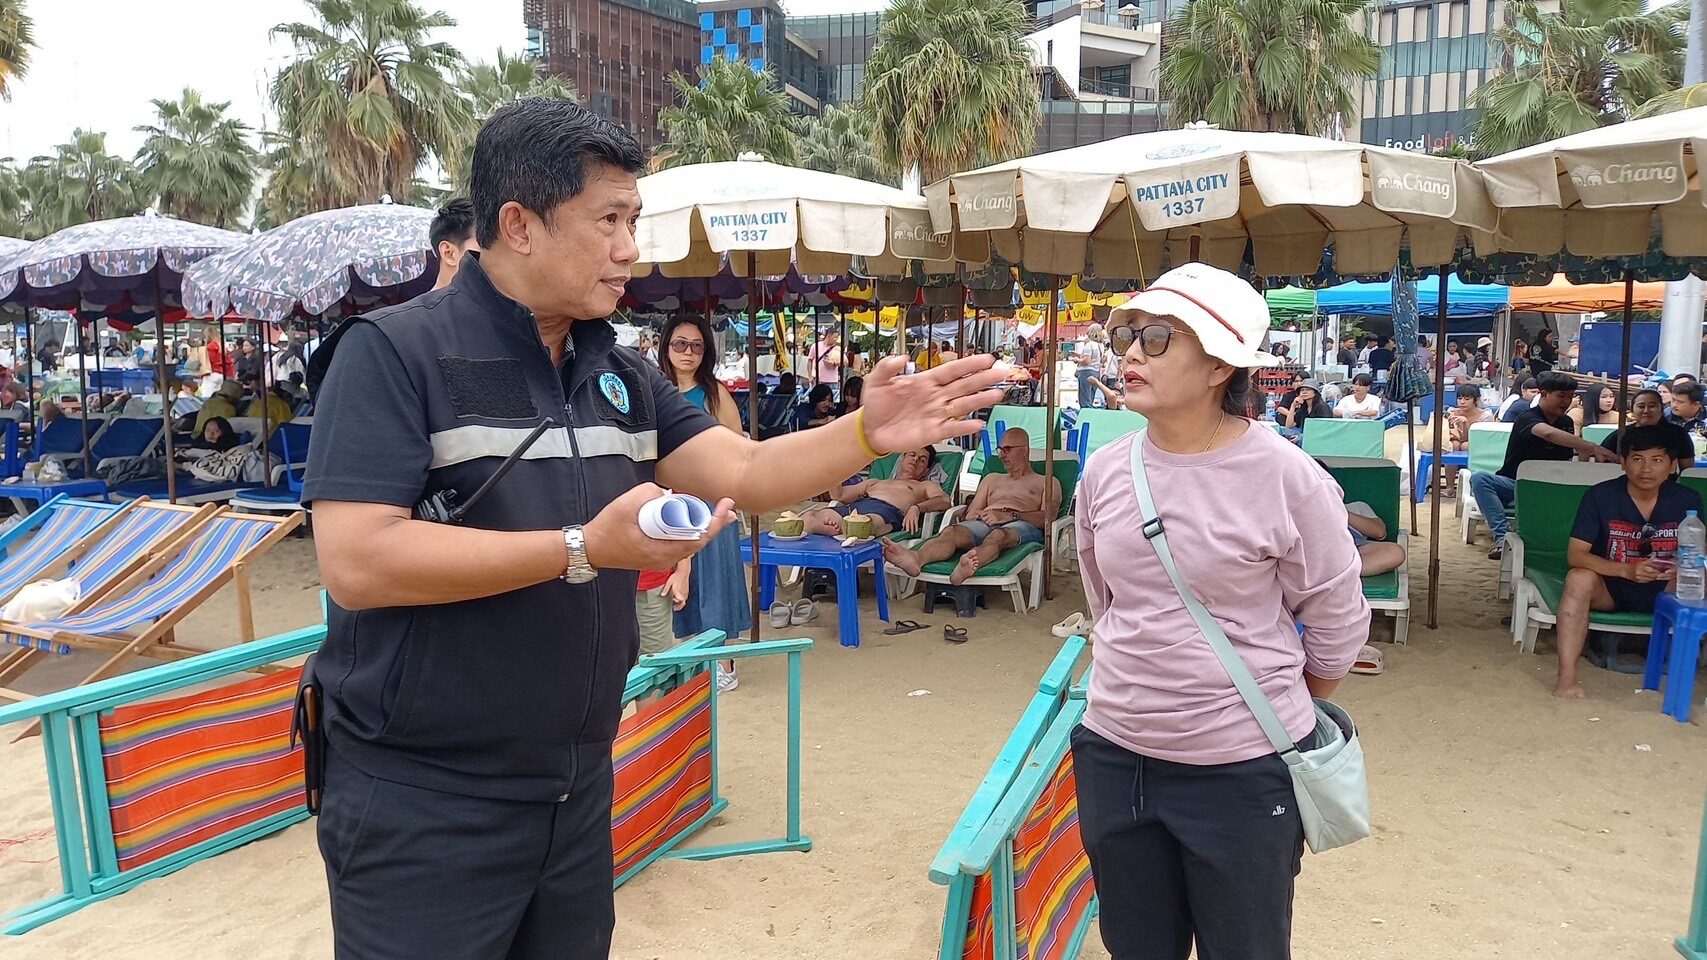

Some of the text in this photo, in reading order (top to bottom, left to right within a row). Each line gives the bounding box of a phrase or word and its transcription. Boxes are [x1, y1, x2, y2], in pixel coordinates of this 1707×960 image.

[1385, 134, 1424, 150] Food
[1604, 164, 1678, 184] Chang
[1136, 173, 1228, 202] PATTAYA CITY
[1403, 172, 1450, 200] Chang
[973, 193, 1012, 212] Chang
[1162, 198, 1205, 217] 1337
[710, 211, 787, 228] PATTAYA CITY
[732, 229, 767, 242] 1337
[1073, 310, 1087, 318] UW
